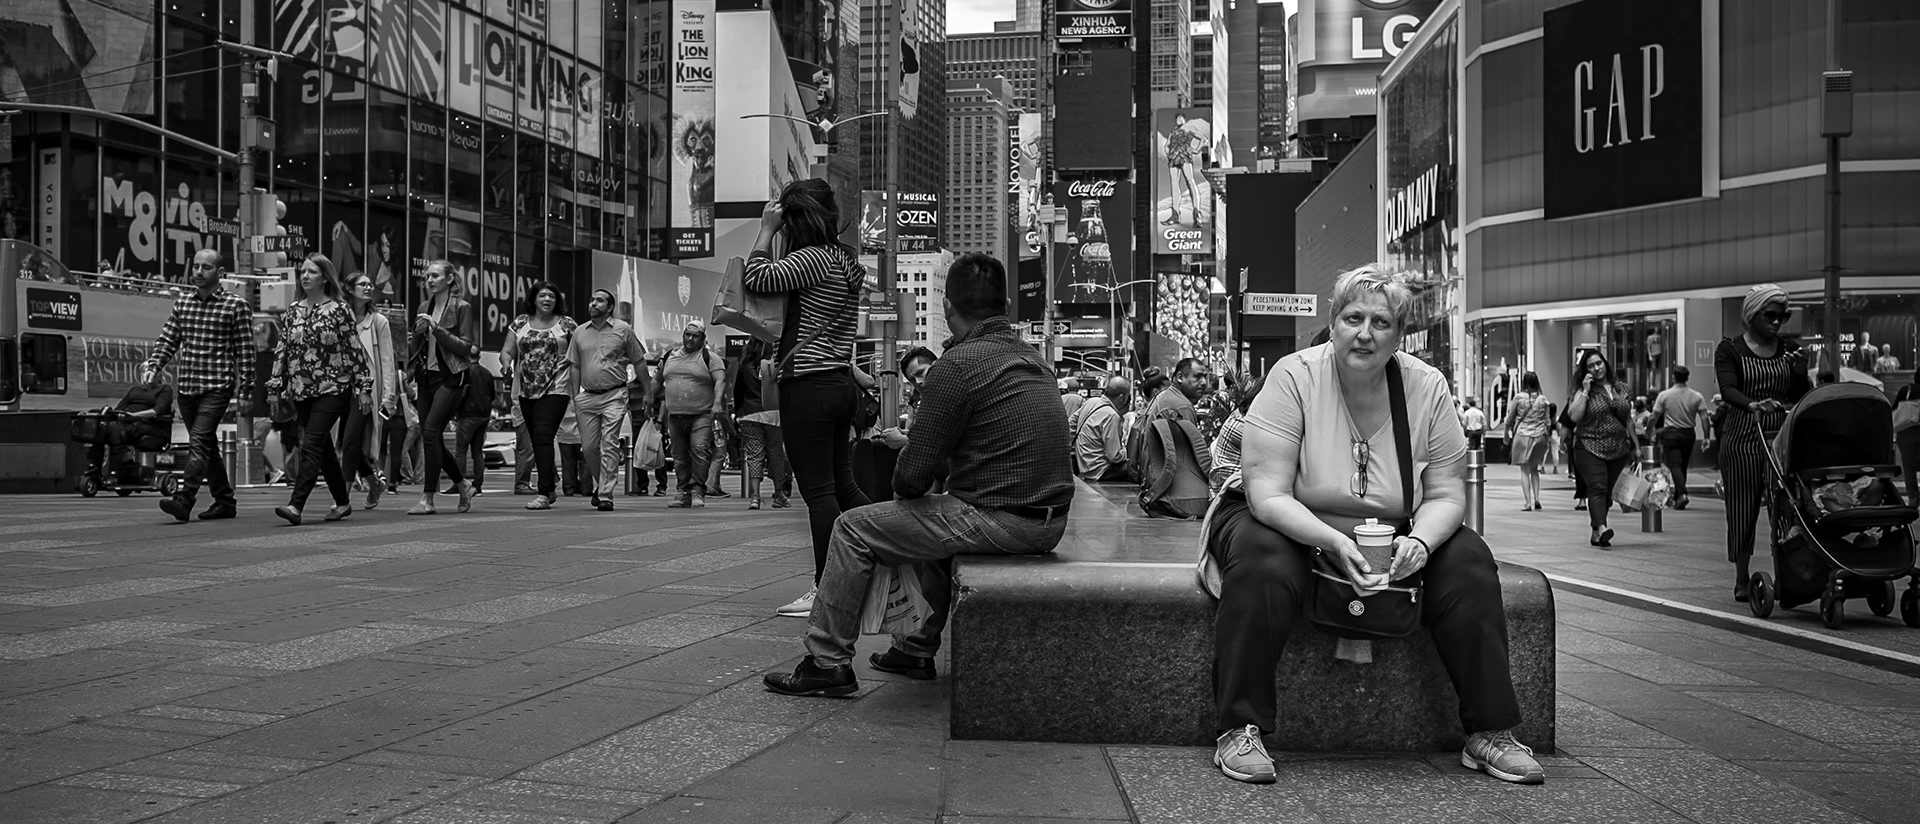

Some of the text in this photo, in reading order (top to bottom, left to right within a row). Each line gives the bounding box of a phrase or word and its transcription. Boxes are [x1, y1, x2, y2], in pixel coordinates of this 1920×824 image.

[679, 10, 705, 20] Disney
[1071, 16, 1117, 27] XINHUA
[681, 29, 703, 40] THE
[1061, 26, 1126, 35] NEWS AGENCY
[1352, 14, 1421, 60] LG
[678, 42, 708, 60] LION
[676, 62, 713, 83] KING
[1574, 44, 1665, 154] GAP
[1068, 180, 1117, 197] Coca-Cola
[904, 193, 937, 202] MUSICAL
[1387, 163, 1439, 245] OLD NAVY
[882, 207, 937, 224] FOZEN
[208, 218, 240, 238] Broadway
[288, 224, 303, 235] SHE
[1163, 228, 1202, 240] Green
[266, 238, 275, 250] W
[279, 237, 291, 250] 44
[901, 240, 909, 250] W
[912, 240, 925, 251] 44
[1168, 239, 1204, 250] Giant
[483, 252, 501, 264] JUNE
[19, 270, 34, 279] 312
[1252, 296, 1284, 304] PEDESTRIAN
[80, 336, 130, 360] YOUR
[84, 360, 147, 383] FASHIO
